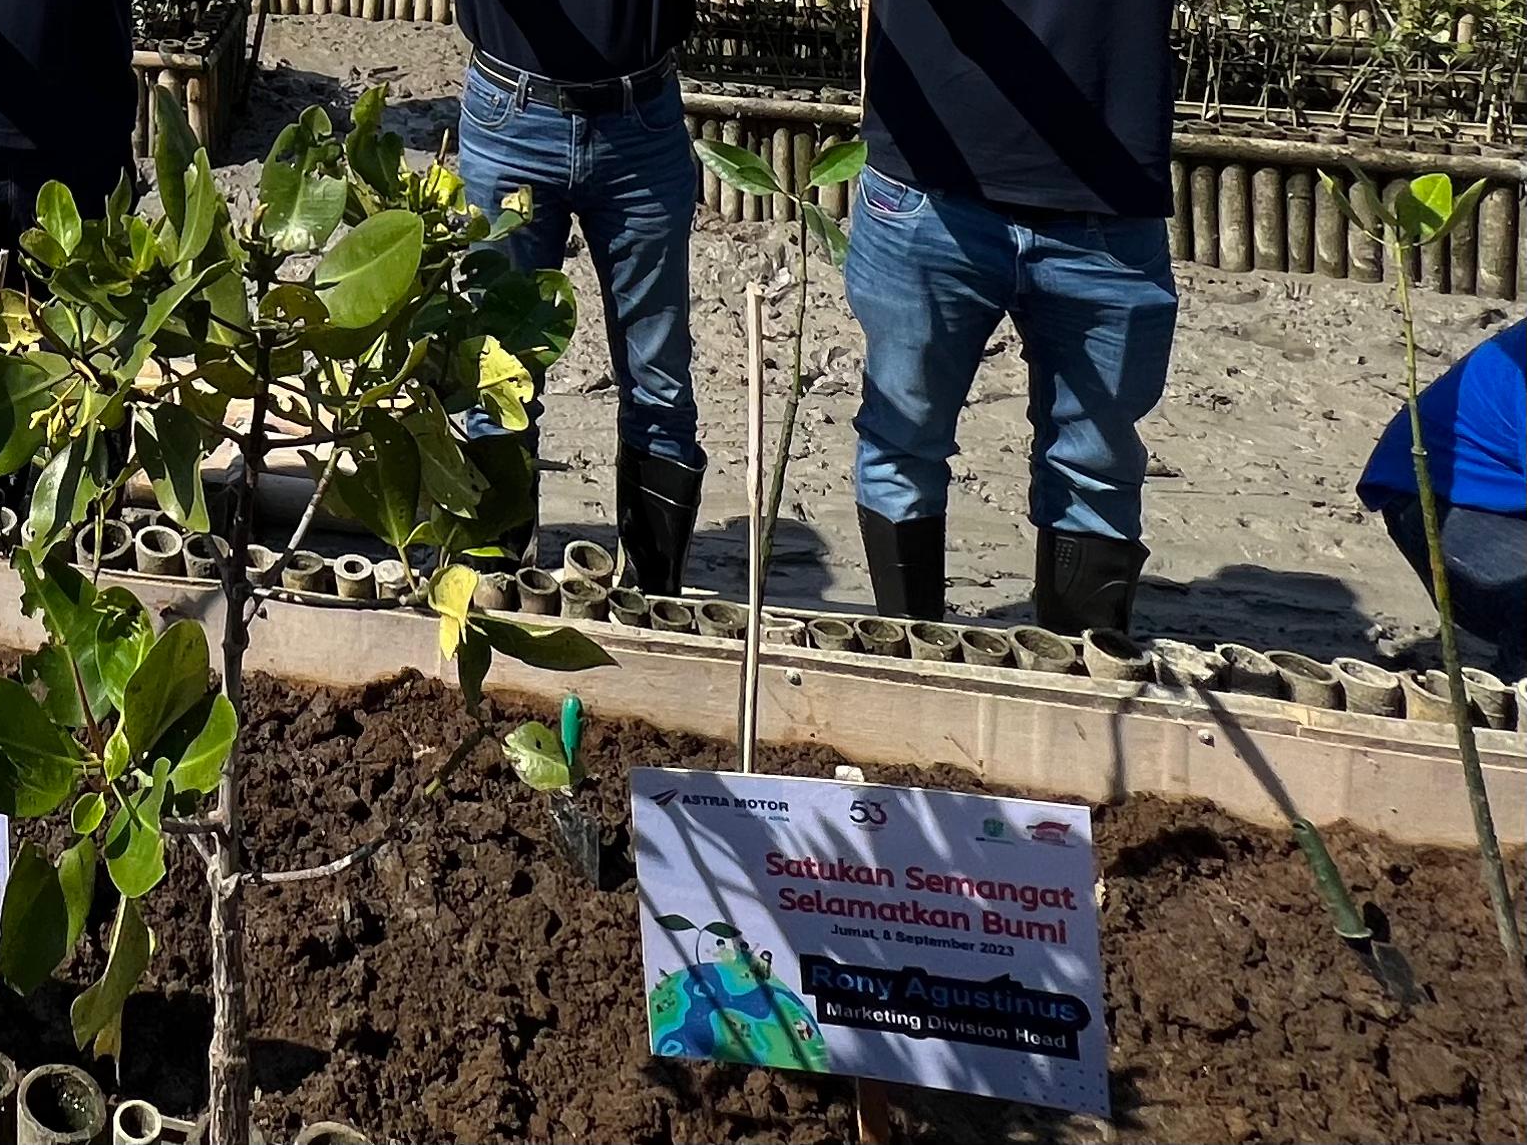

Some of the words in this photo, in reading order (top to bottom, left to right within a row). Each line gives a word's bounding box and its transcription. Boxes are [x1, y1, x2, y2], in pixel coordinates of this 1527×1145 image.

[682, 795, 730, 808] ASTRA
[734, 798, 789, 812] MOTOR
[849, 800, 887, 825] 53
[766, 852, 895, 888] Satukan
[905, 866, 1078, 912] Semangat
[778, 887, 971, 932] Selamatkan
[982, 909, 1068, 944] Bumi
[831, 923, 878, 941] Jumat,
[895, 930, 975, 953] September
[980, 941, 1015, 957] 2023
[810, 964, 892, 1001] Rony
[905, 976, 1080, 1023] Agustinus
[826, 1001, 921, 1030] Marketing
[928, 1014, 1009, 1040] Division
[1015, 1027, 1068, 1050] Head
